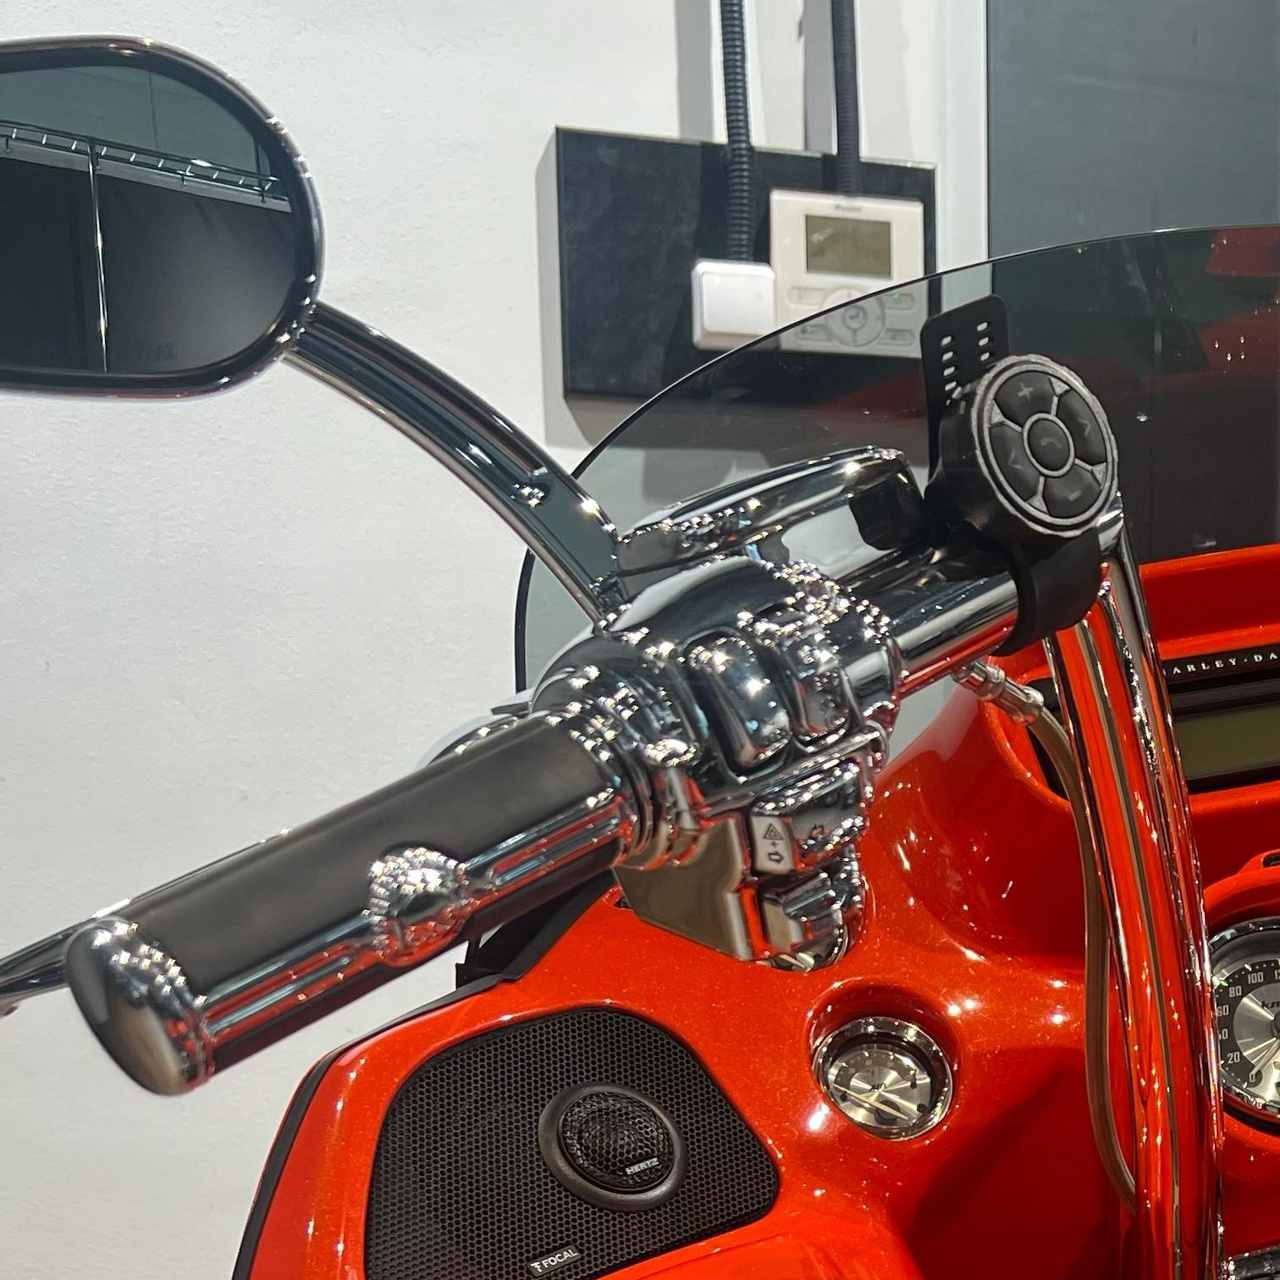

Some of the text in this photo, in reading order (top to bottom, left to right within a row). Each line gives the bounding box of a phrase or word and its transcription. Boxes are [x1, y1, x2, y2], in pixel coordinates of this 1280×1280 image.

[1247, 972, 1264, 985] 100
[1229, 985, 1242, 998] 80
[1227, 1052, 1240, 1064] 20
[541, 1248, 579, 1270] FOCAL
